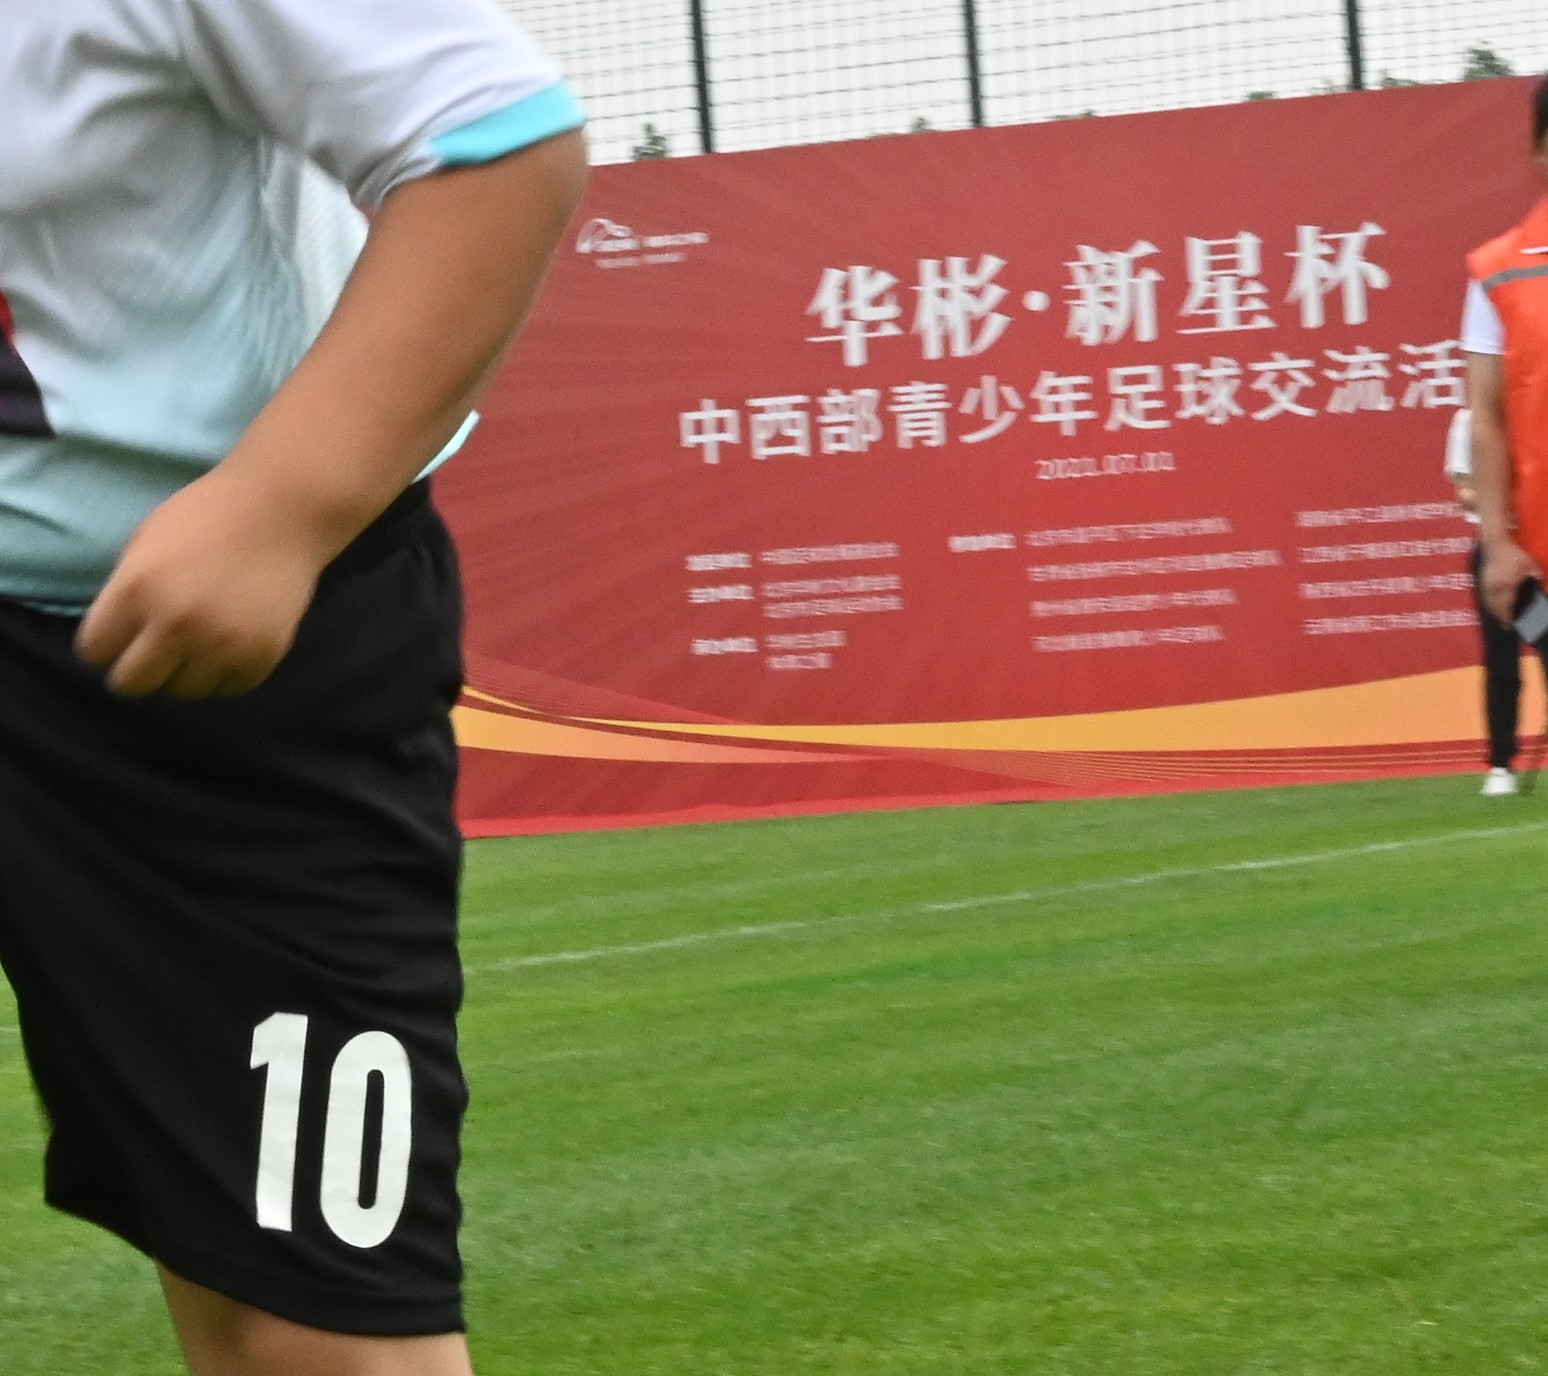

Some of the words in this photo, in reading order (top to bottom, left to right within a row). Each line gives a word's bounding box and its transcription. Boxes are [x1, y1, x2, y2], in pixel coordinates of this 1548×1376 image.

[806, 221, 1391, 368] 华彬·新星杯
[679, 338, 1469, 464] 中西部青少年足球交流活
[249, 1012, 413, 1250] 10
